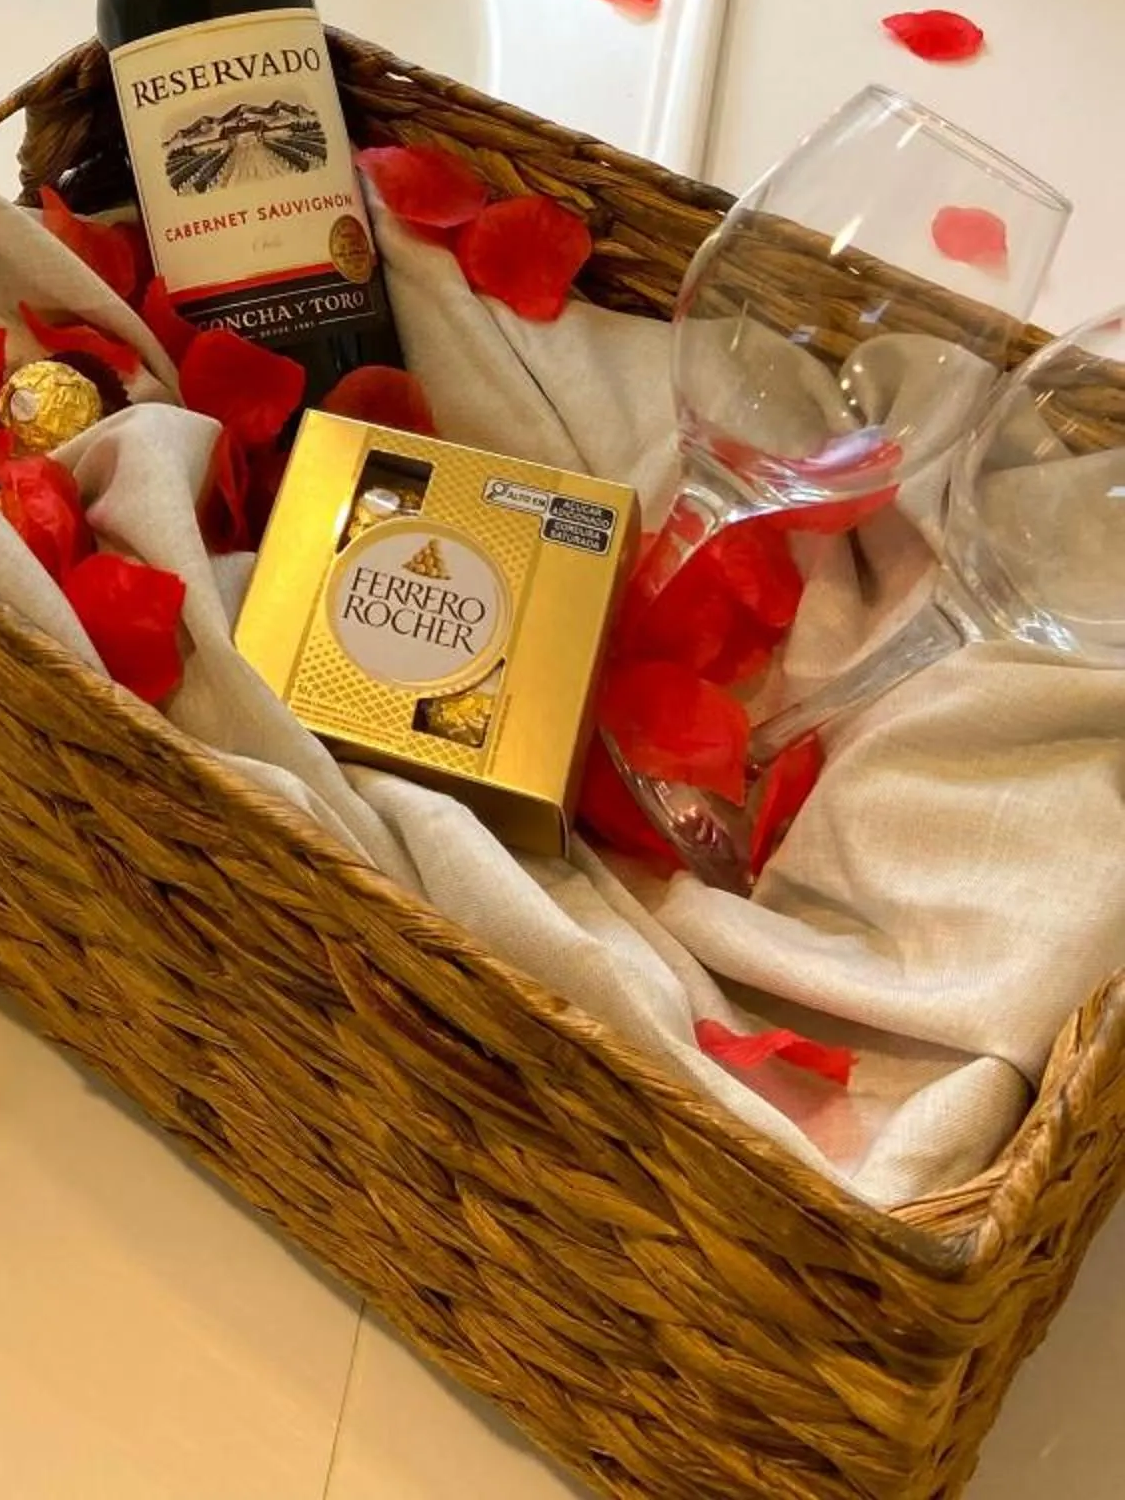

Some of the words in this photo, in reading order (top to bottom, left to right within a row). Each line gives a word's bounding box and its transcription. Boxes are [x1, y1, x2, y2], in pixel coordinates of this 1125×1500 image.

[132, 48, 320, 108] RESERVADO
[165, 209, 248, 243] CABERNET
[257, 193, 353, 224] SAUVIGNON
[295, 301, 306, 315] Y
[309, 291, 364, 314] TORO
[342, 594, 475, 655] ROCHER
[350, 566, 486, 625] FERRERO
